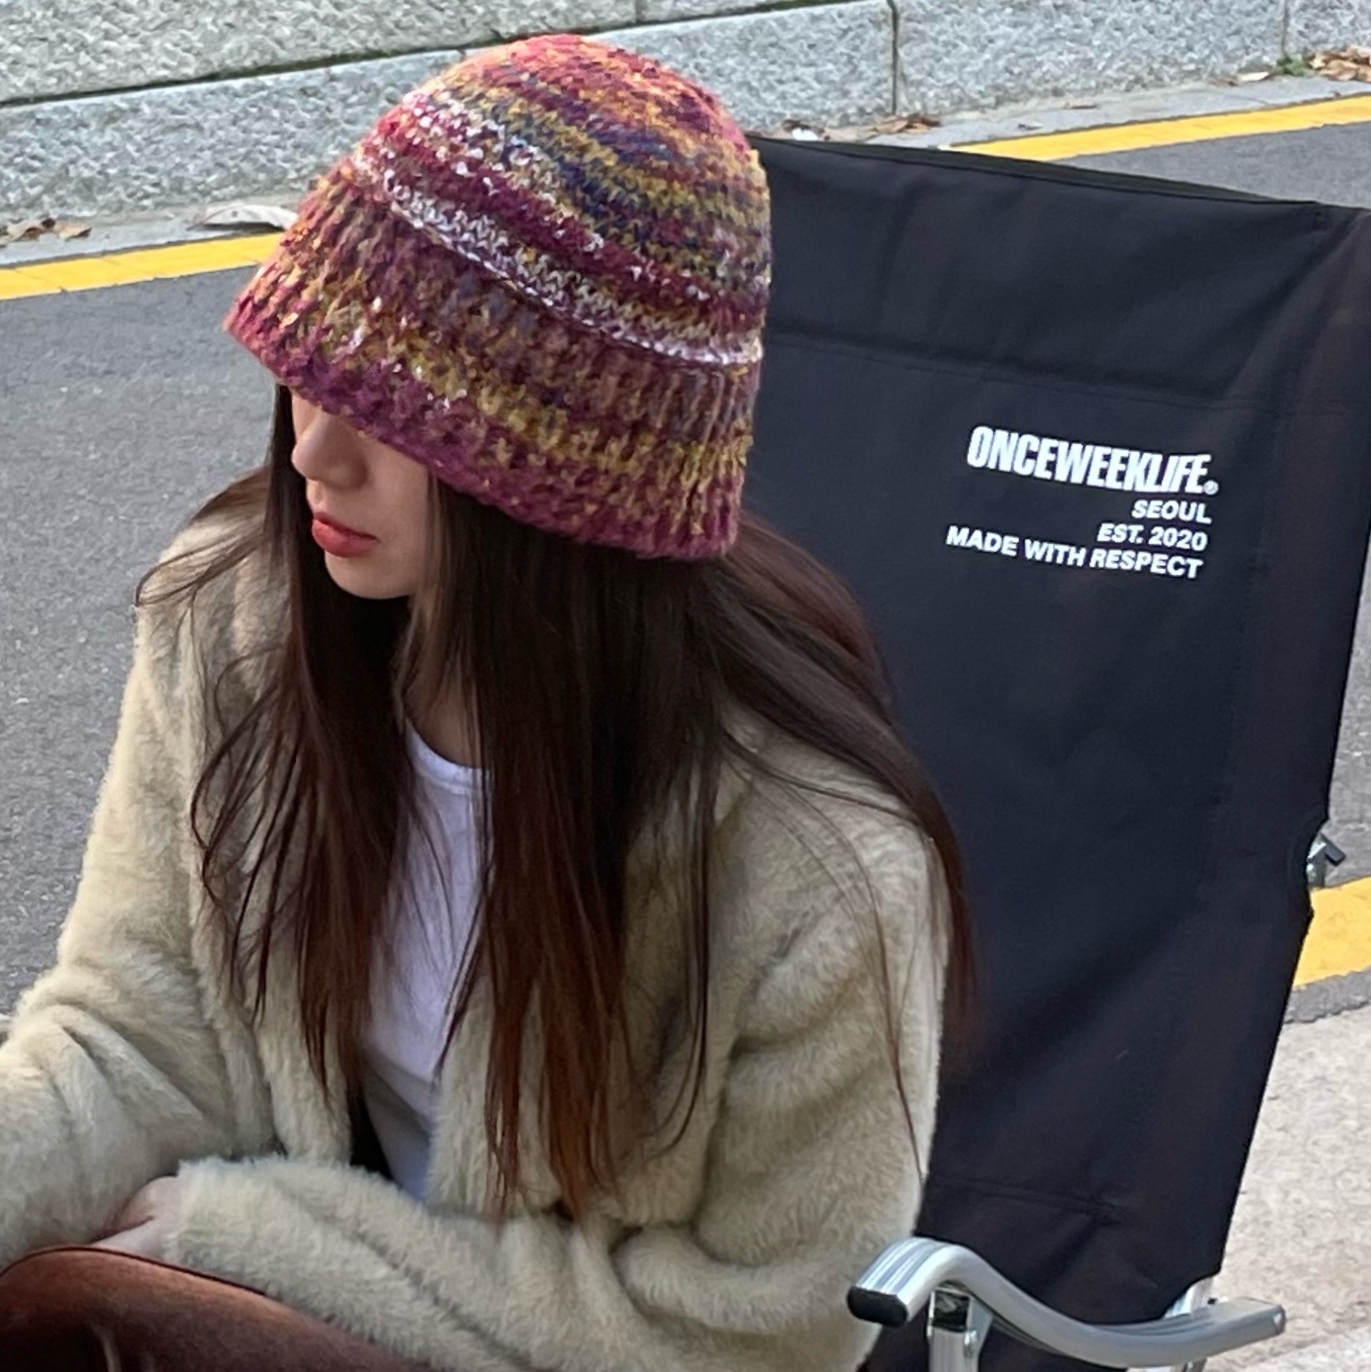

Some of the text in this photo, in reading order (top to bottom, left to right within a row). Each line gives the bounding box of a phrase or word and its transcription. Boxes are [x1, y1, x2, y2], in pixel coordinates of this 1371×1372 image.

[1131, 499, 1213, 525] SEOUL
[1096, 522, 1208, 551] EST. 2020
[945, 525, 1204, 579] MADE WITH RESPECT
